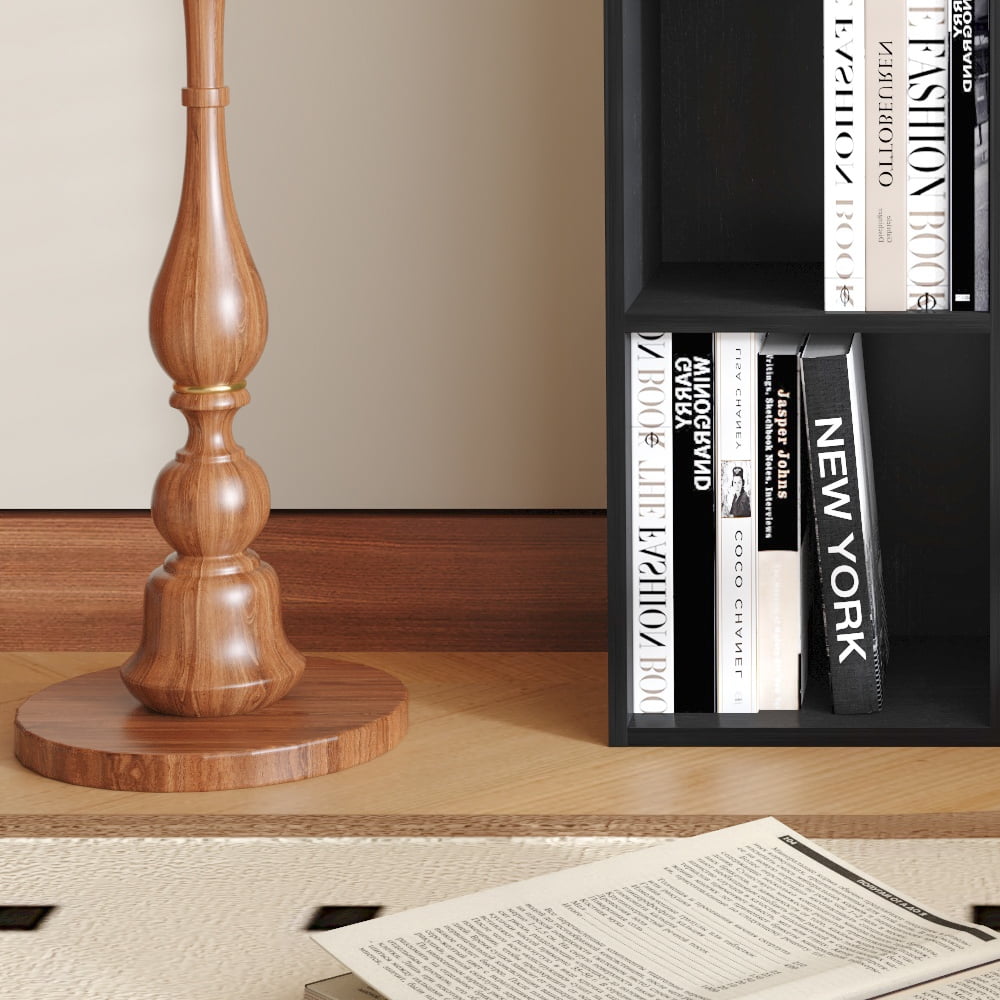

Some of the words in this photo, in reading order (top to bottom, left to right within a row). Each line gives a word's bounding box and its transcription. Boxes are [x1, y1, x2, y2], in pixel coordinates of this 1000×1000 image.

[907, 39, 947, 198] FASHION
[765, 398, 774, 451] Sketchbook
[776, 389, 791, 446] Jasper
[777, 450, 791, 500] Johns
[814, 416, 853, 521] NEW
[765, 486, 774, 539] Interviews
[827, 531, 867, 665] YORK
